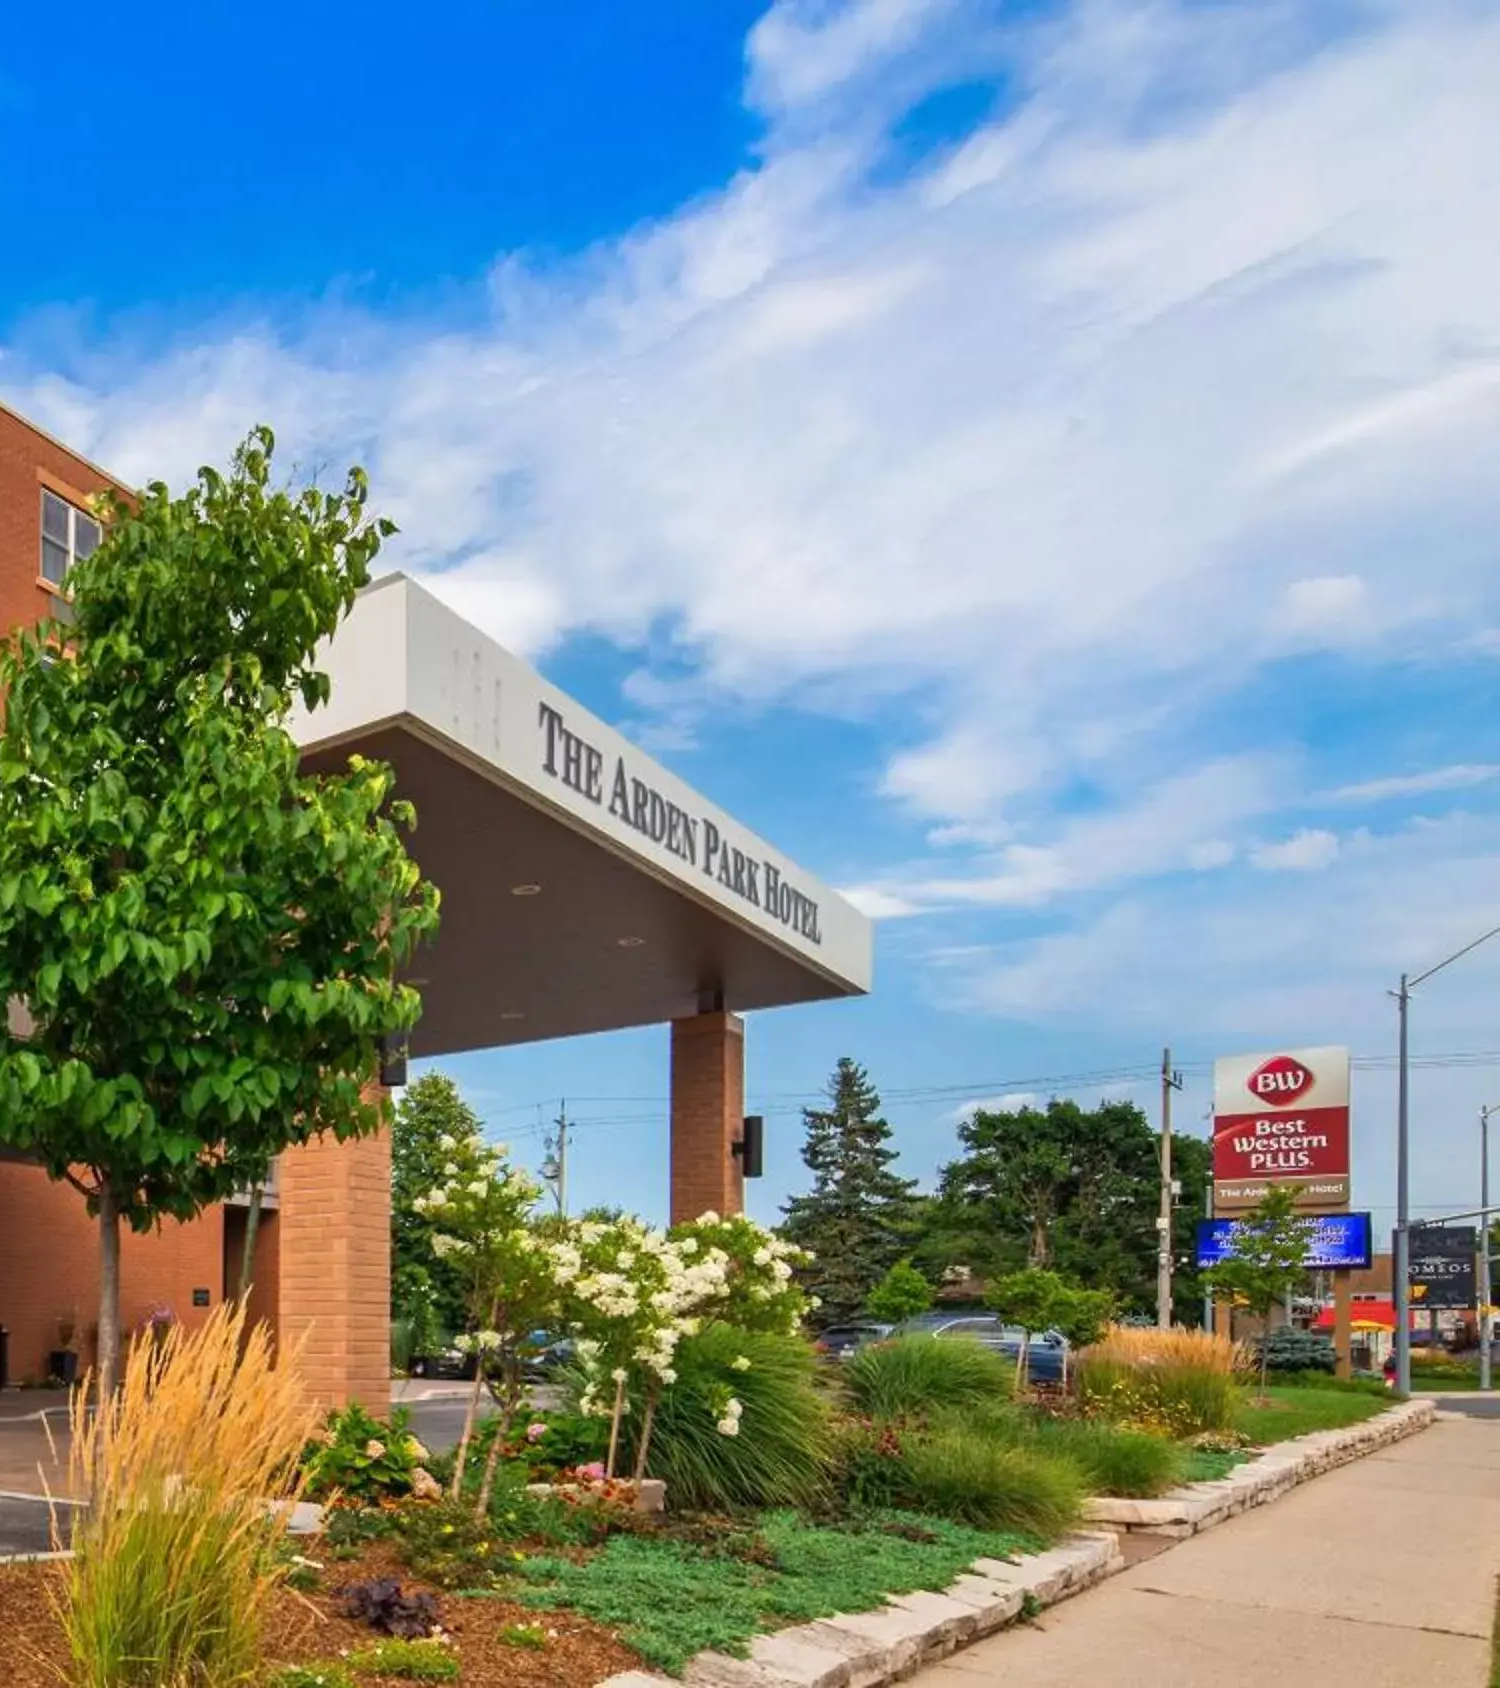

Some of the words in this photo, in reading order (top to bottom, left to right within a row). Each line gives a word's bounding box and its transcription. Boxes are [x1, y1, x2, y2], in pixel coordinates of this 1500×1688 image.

[538, 701, 603, 805] THE
[608, 756, 699, 867] ARDEN
[701, 817, 760, 908] PARK
[763, 860, 821, 946] HOTEL
[1256, 1068, 1306, 1093] BW
[1255, 1119, 1307, 1136] Best
[1233, 1135, 1328, 1153] Western
[1250, 1150, 1311, 1169] PLUS
[1408, 1263, 1472, 1275] OMEOS
